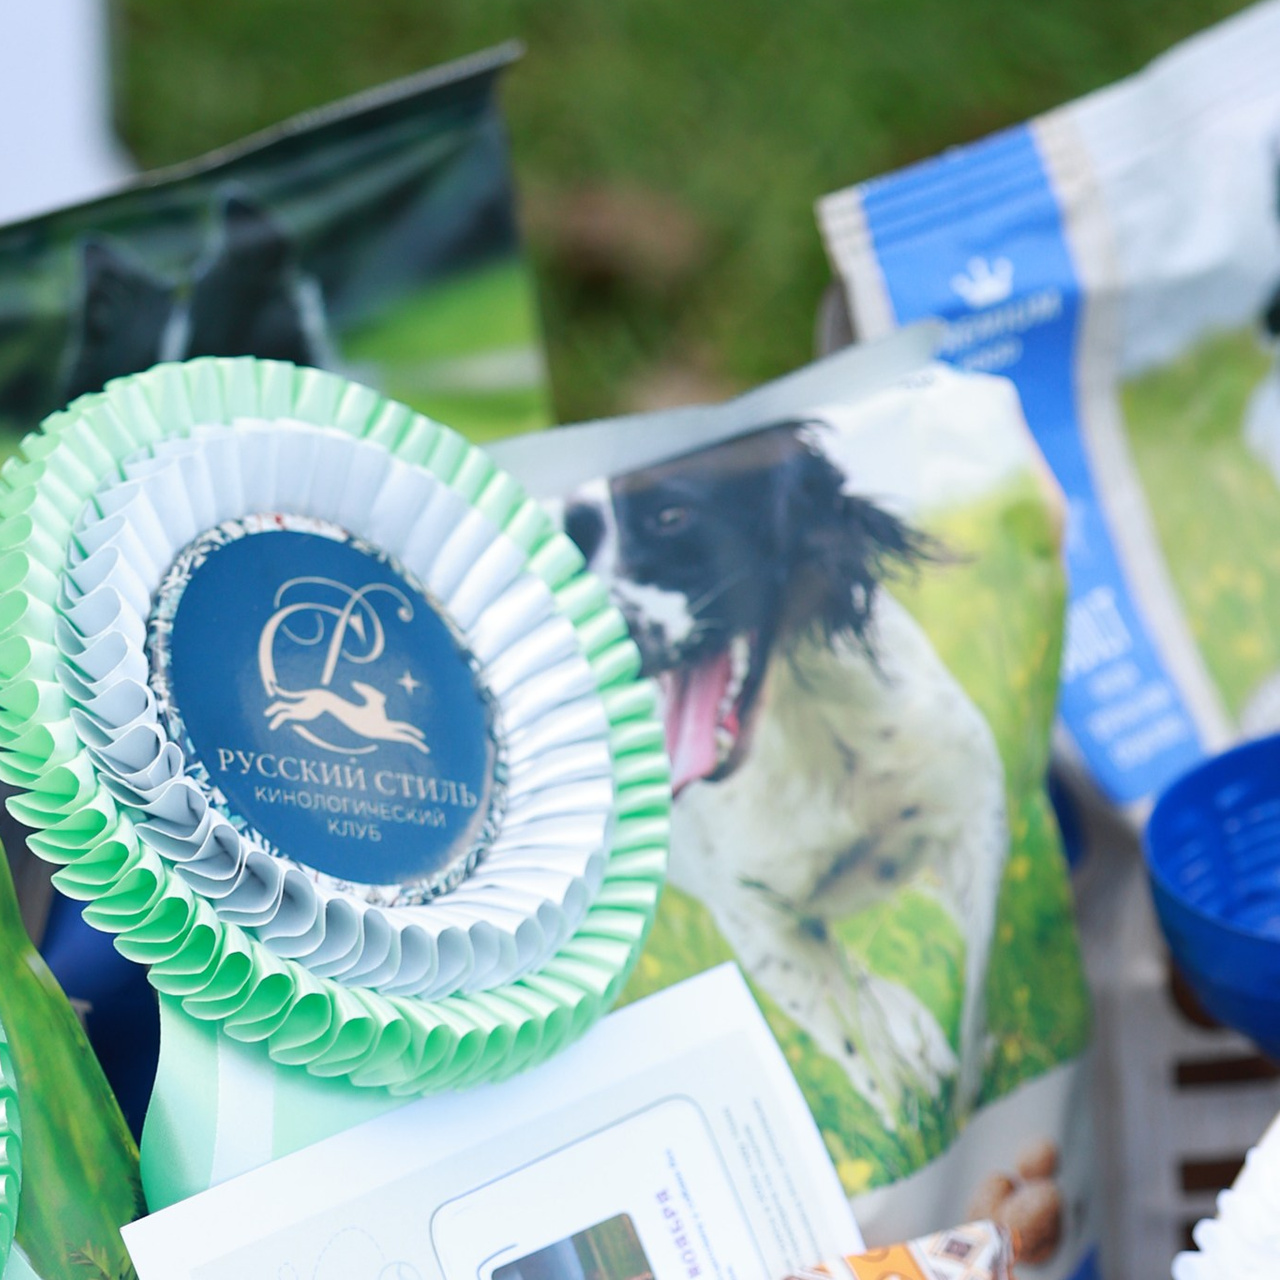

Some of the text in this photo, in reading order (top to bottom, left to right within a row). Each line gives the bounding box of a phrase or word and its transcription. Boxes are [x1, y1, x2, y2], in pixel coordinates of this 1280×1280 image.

[217, 747, 479, 810] РУССКИЙ СТИЛЬ
[253, 785, 447, 828] КИНОЛОГИЧЕСКИЙ
[326, 818, 383, 843] КЛУБ
